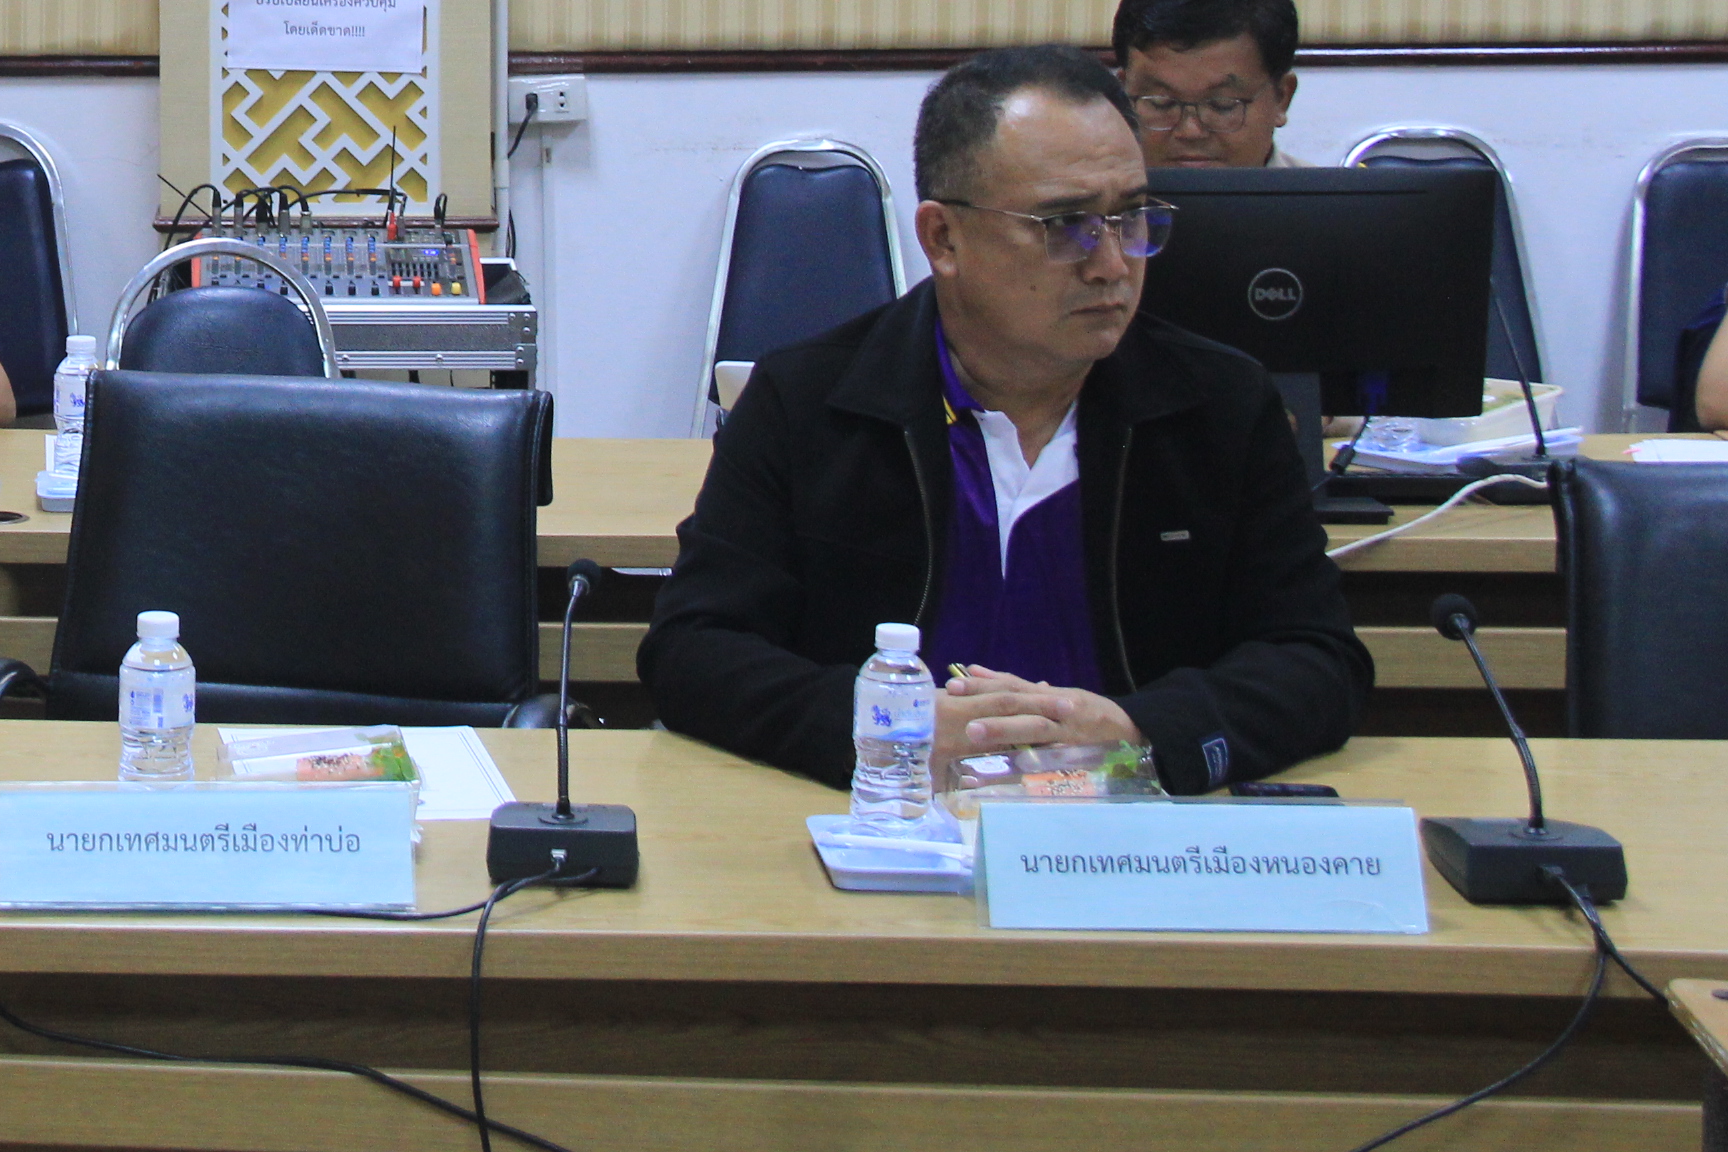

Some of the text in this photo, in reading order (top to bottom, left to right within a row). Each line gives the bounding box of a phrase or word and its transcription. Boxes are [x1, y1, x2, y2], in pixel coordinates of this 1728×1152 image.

[1255, 287, 1297, 301] DELL
[45, 822, 362, 854] นายกเทศมนตรีเมืองท่าบ่อ
[1019, 845, 1382, 877] นายกเทศมนตรีเมืองหนองคาย
